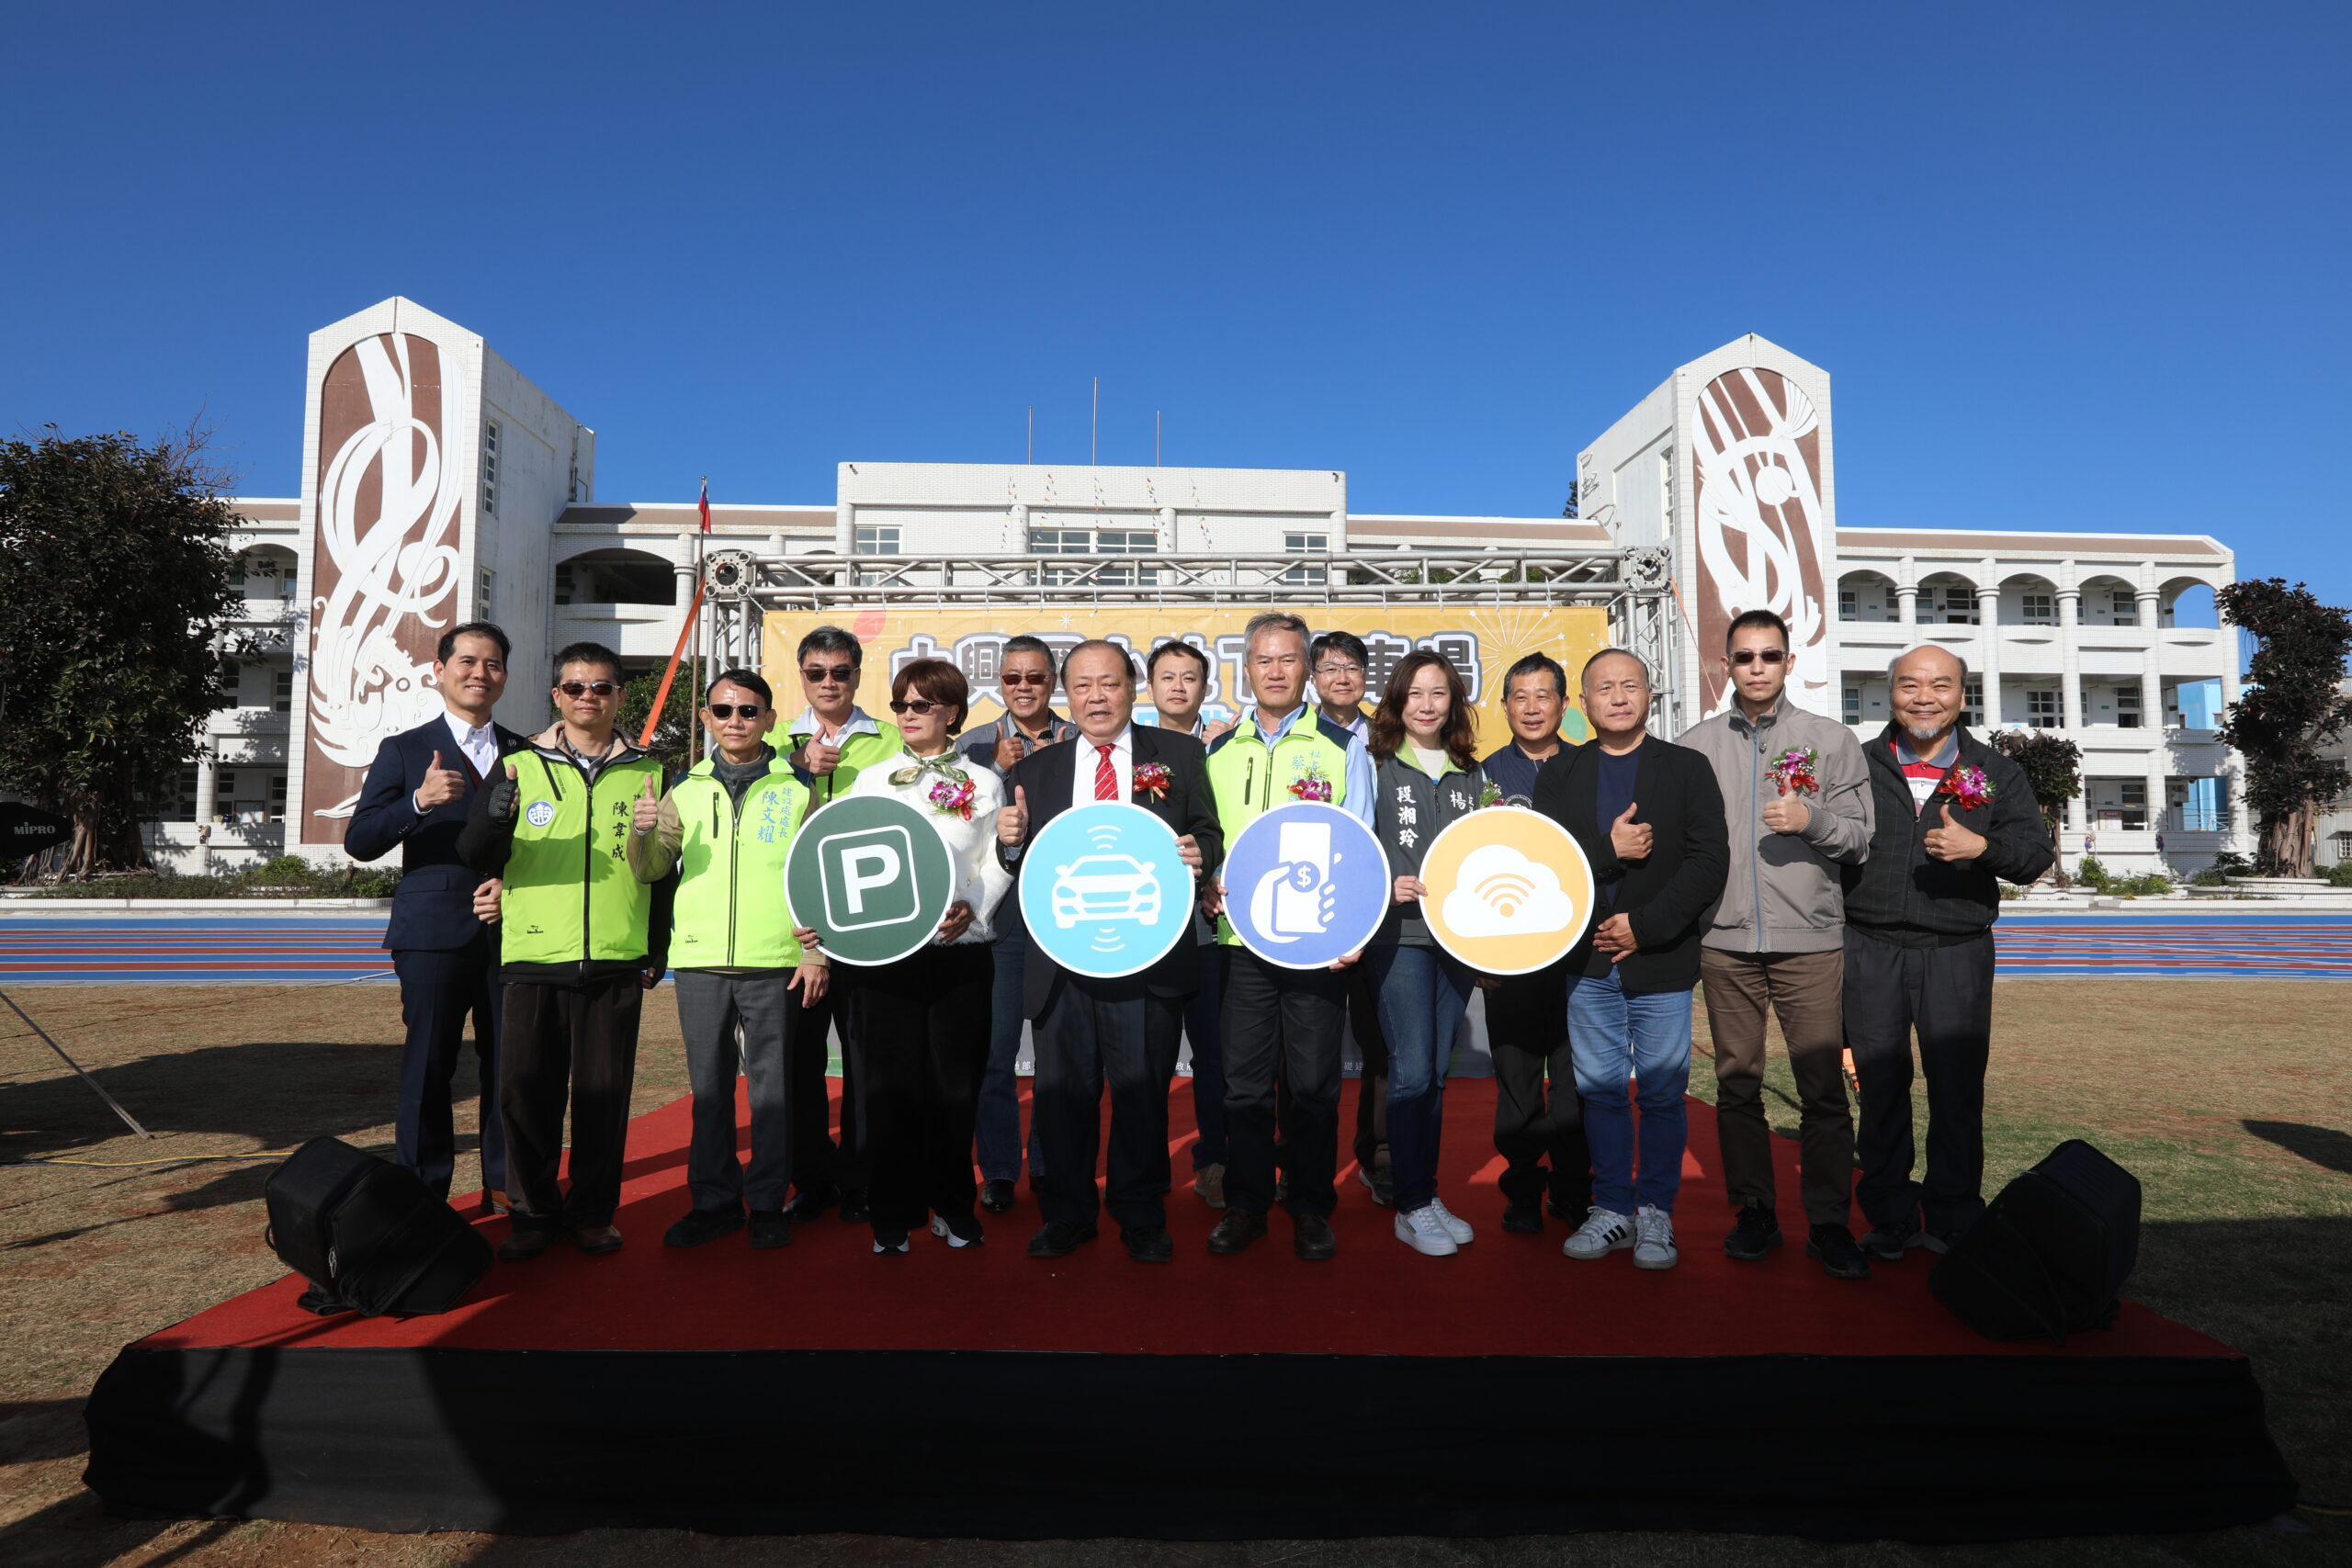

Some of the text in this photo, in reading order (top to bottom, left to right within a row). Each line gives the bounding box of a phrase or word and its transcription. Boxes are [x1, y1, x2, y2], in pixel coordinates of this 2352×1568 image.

[612, 801, 628, 861] 陳韋成
[1396, 785, 1419, 848] 段湘玲
[841, 844, 900, 915] P
